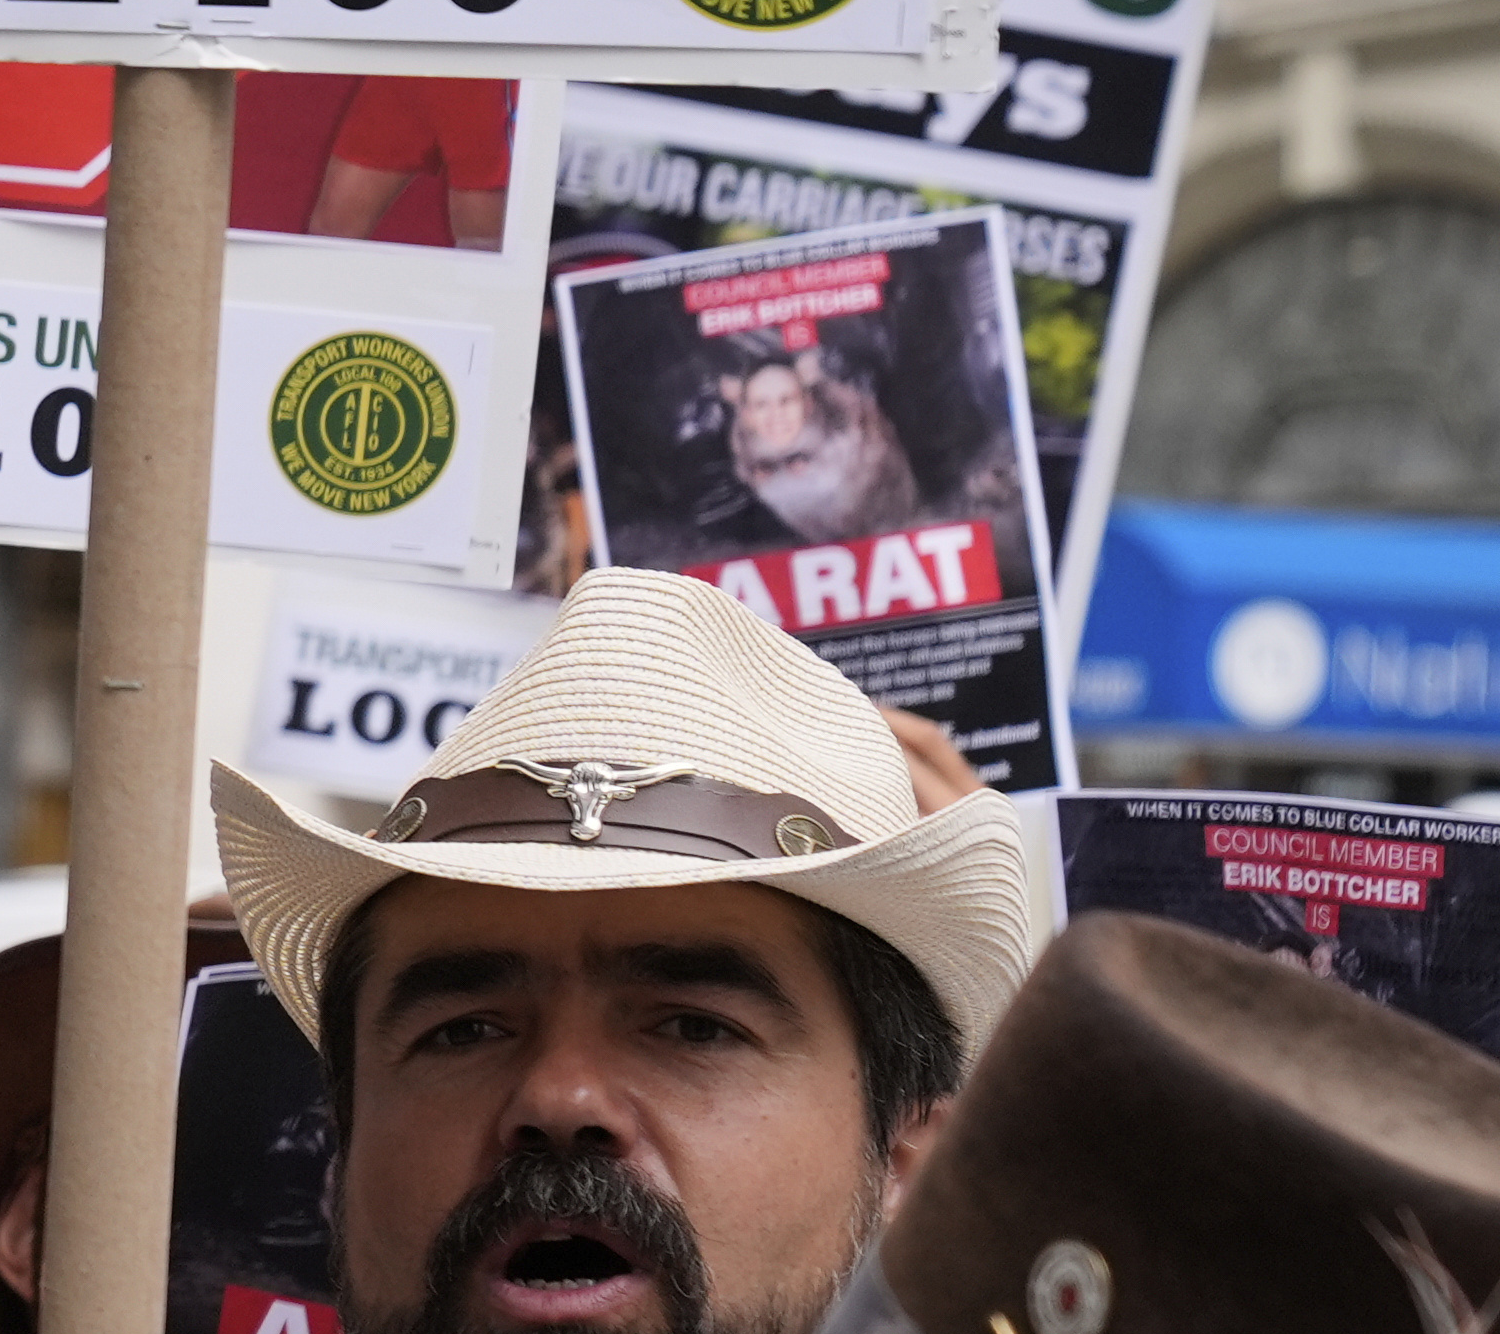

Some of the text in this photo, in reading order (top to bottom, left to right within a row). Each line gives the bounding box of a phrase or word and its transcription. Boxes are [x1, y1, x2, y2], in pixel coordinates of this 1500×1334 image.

[793, 527, 973, 627] RAT
[1127, 802, 1500, 846] WHEN IT COMES TO BLUE COLLAR WORKER
[1212, 828, 1438, 872] COUNCIL MEMBER
[1223, 862, 1419, 905] ERIK BOTTCHER
[1312, 904, 1330, 929] IS
